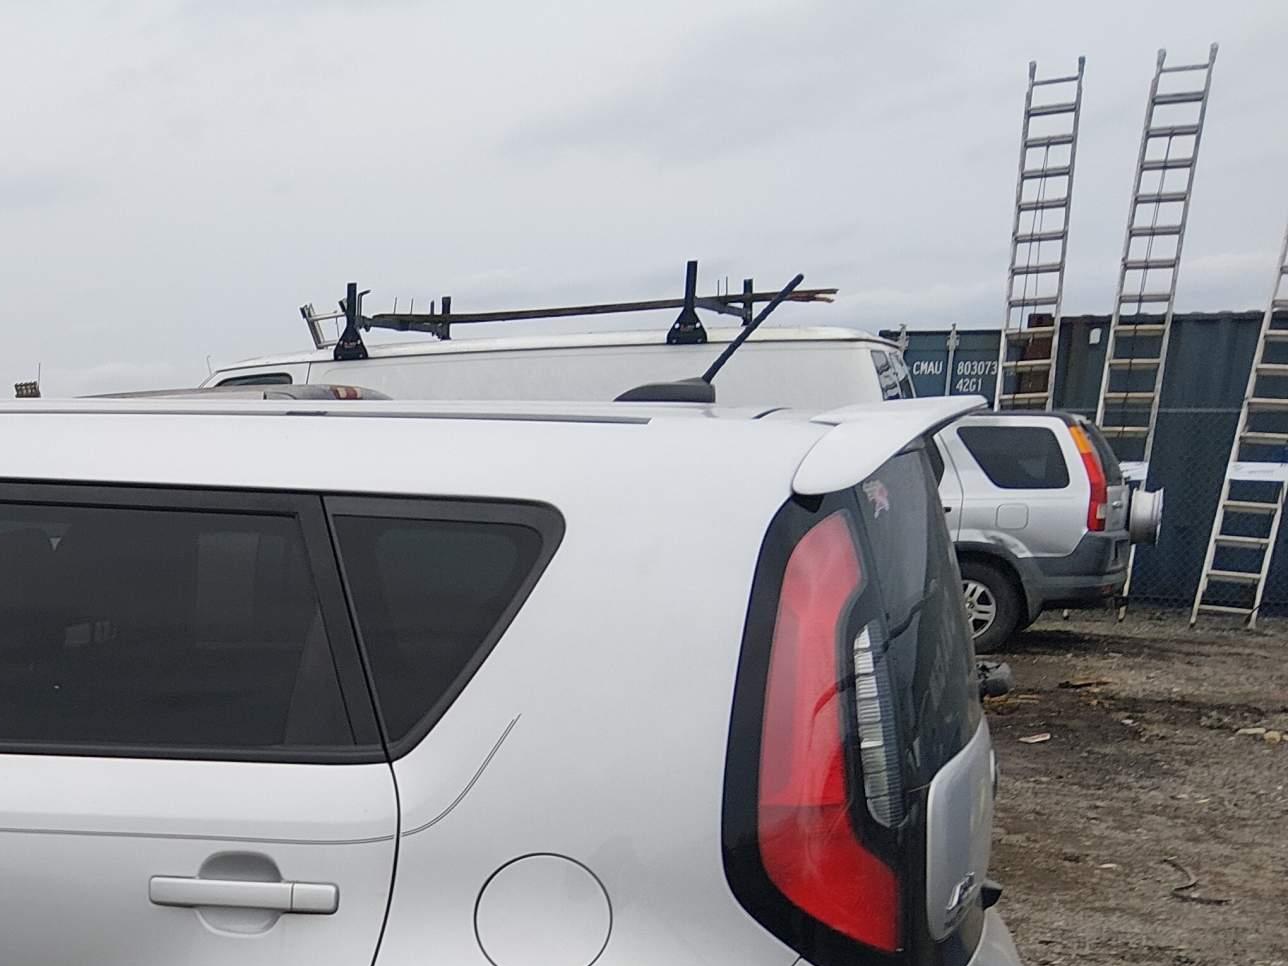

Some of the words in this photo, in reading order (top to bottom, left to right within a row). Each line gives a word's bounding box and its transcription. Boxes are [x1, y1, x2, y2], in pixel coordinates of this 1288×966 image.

[913, 361, 943, 375] CMAU
[957, 361, 997, 375] 803073
[956, 378, 982, 392] 42G1
